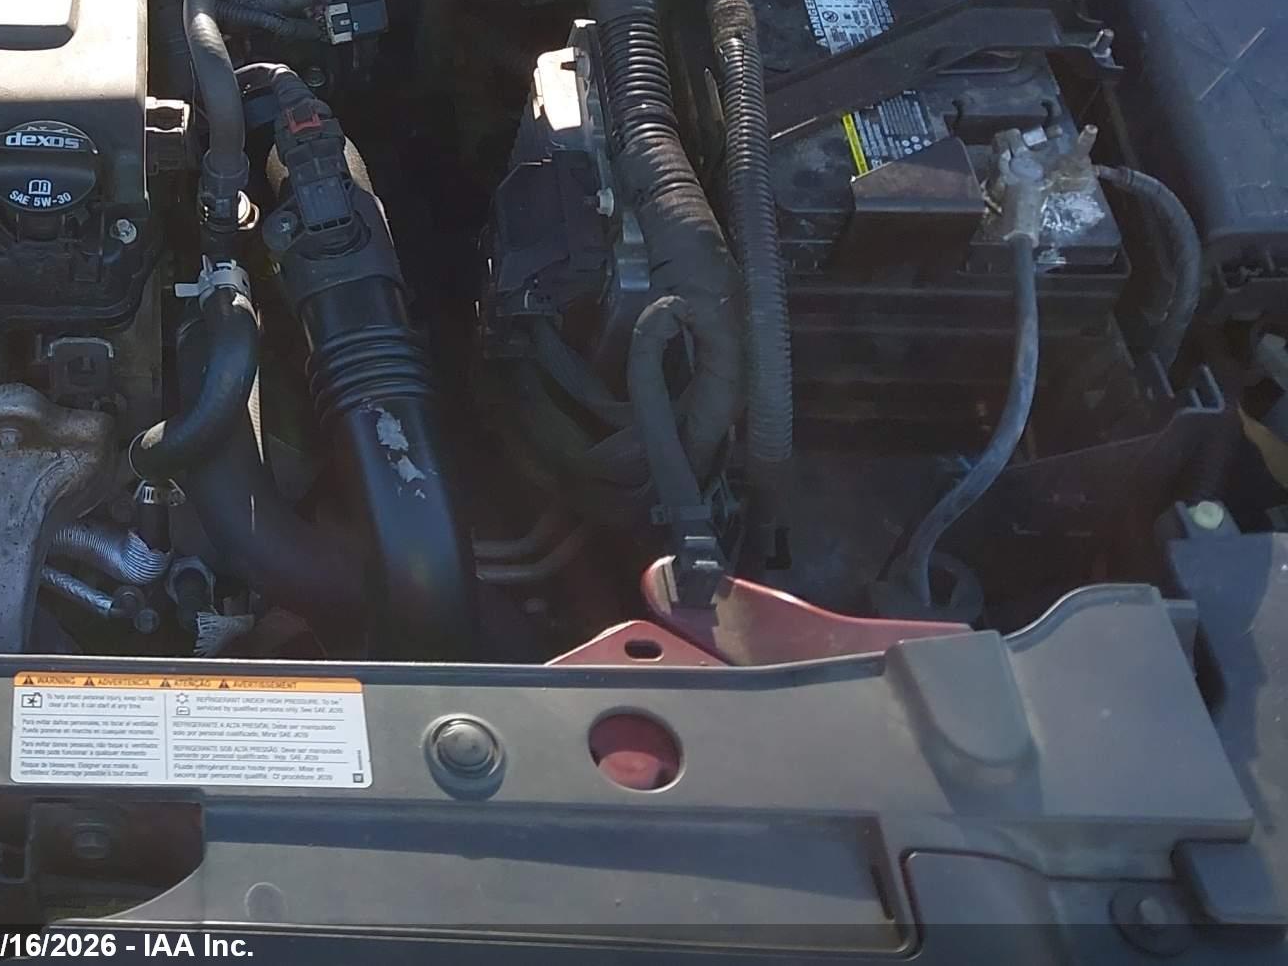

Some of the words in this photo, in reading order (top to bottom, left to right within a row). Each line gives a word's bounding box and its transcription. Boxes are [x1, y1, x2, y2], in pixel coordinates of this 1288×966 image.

[5, 132, 80, 149] dexos
[9, 190, 31, 205] SAE
[33, 192, 72, 207] 5W-30
[36, 676, 76, 685] WARNING
